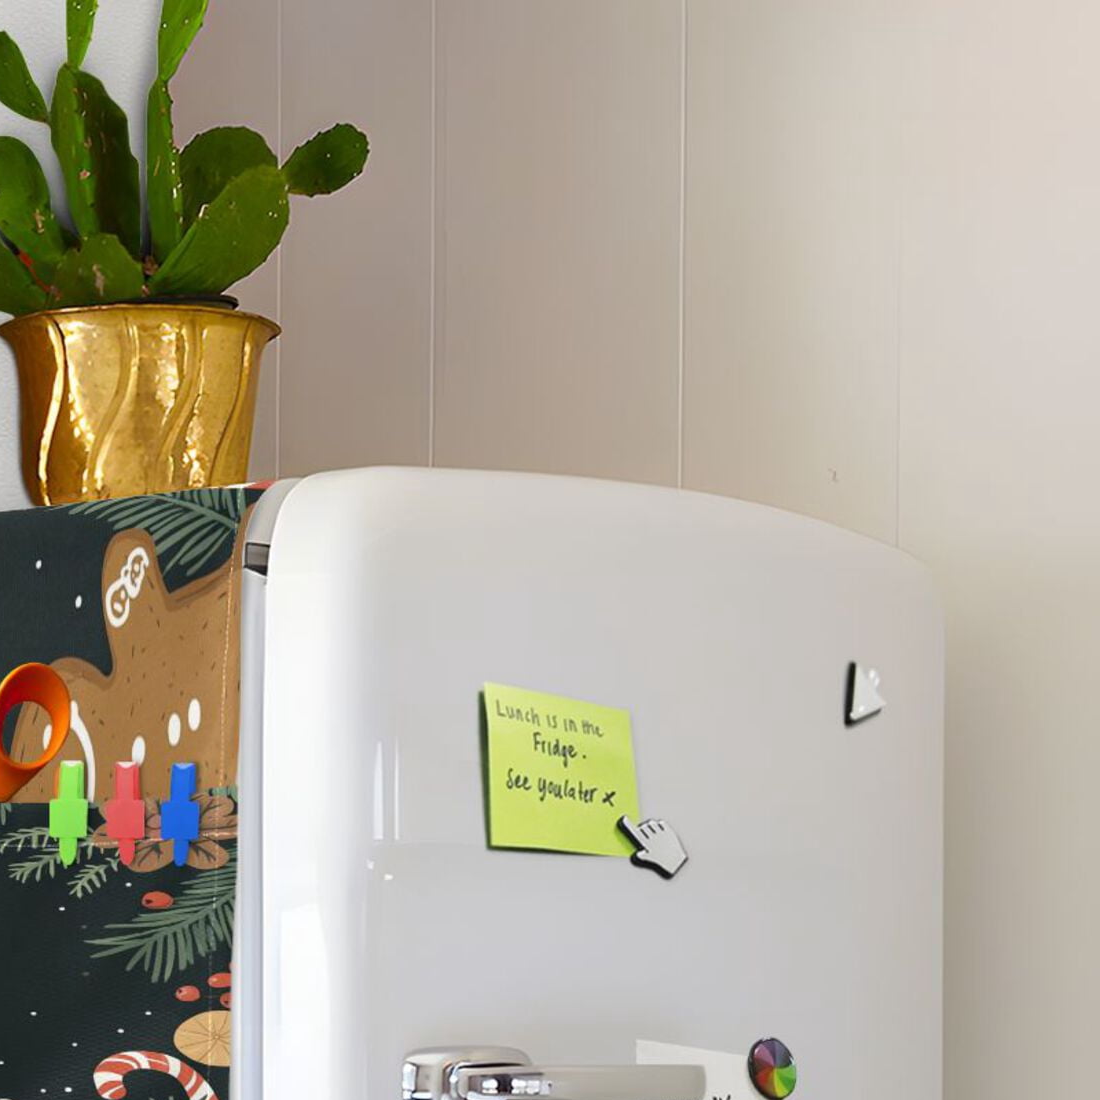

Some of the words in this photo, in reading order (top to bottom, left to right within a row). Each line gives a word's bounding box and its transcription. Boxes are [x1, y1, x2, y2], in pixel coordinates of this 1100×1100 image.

[495, 699, 541, 727] Lunch
[545, 714, 558, 729] is
[563, 718, 578, 733] in
[581, 719, 604, 738] the
[505, 767, 533, 792] See
